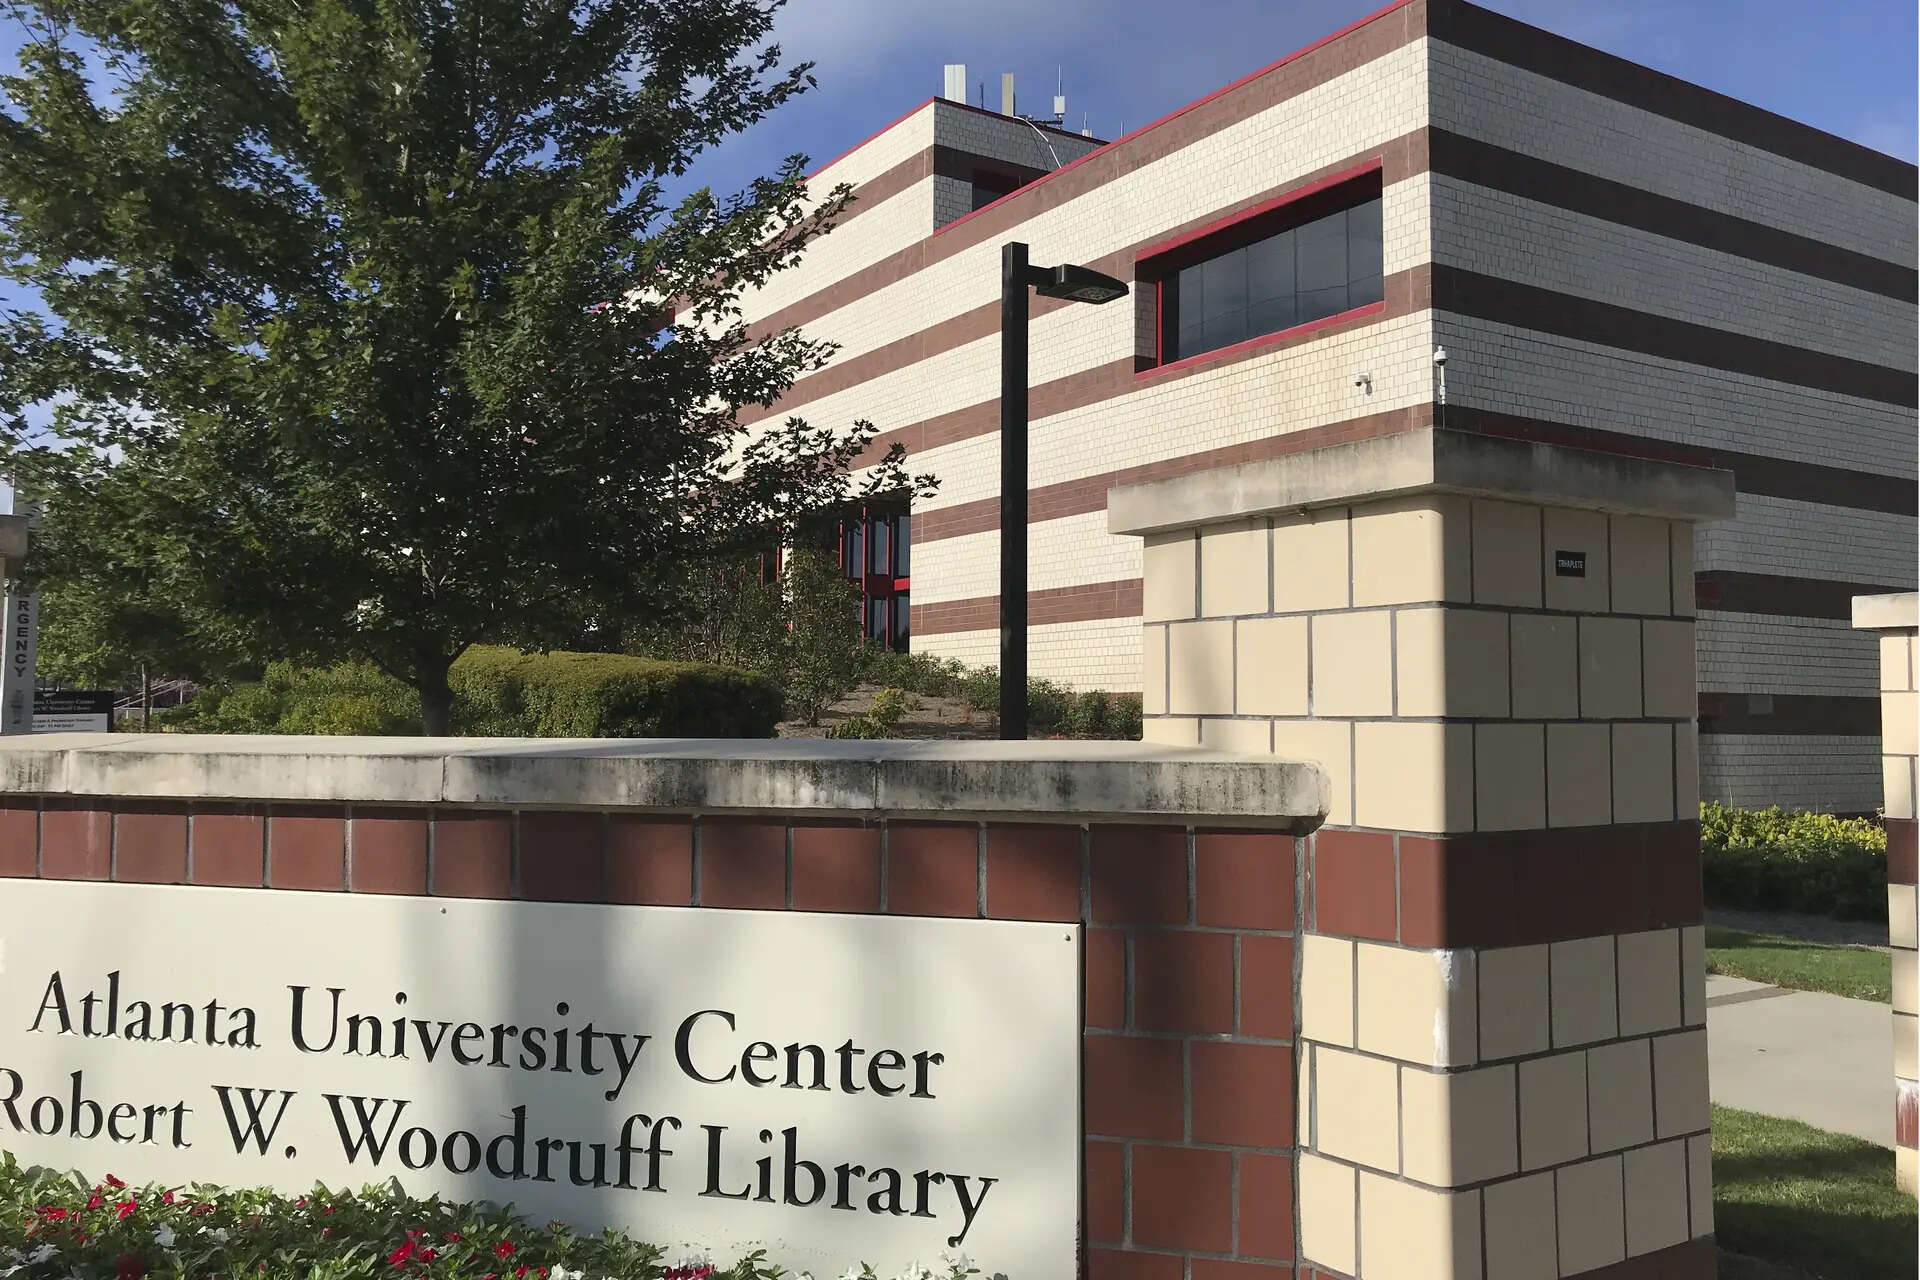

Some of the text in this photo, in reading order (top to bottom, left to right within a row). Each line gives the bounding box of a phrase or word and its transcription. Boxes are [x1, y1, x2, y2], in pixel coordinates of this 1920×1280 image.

[14, 595, 30, 677] RGENCY
[26, 970, 945, 1101] Atlanta University Center
[211, 1085, 298, 1160] W.
[321, 1093, 682, 1193] Woodruff
[698, 1124, 999, 1248] Library
